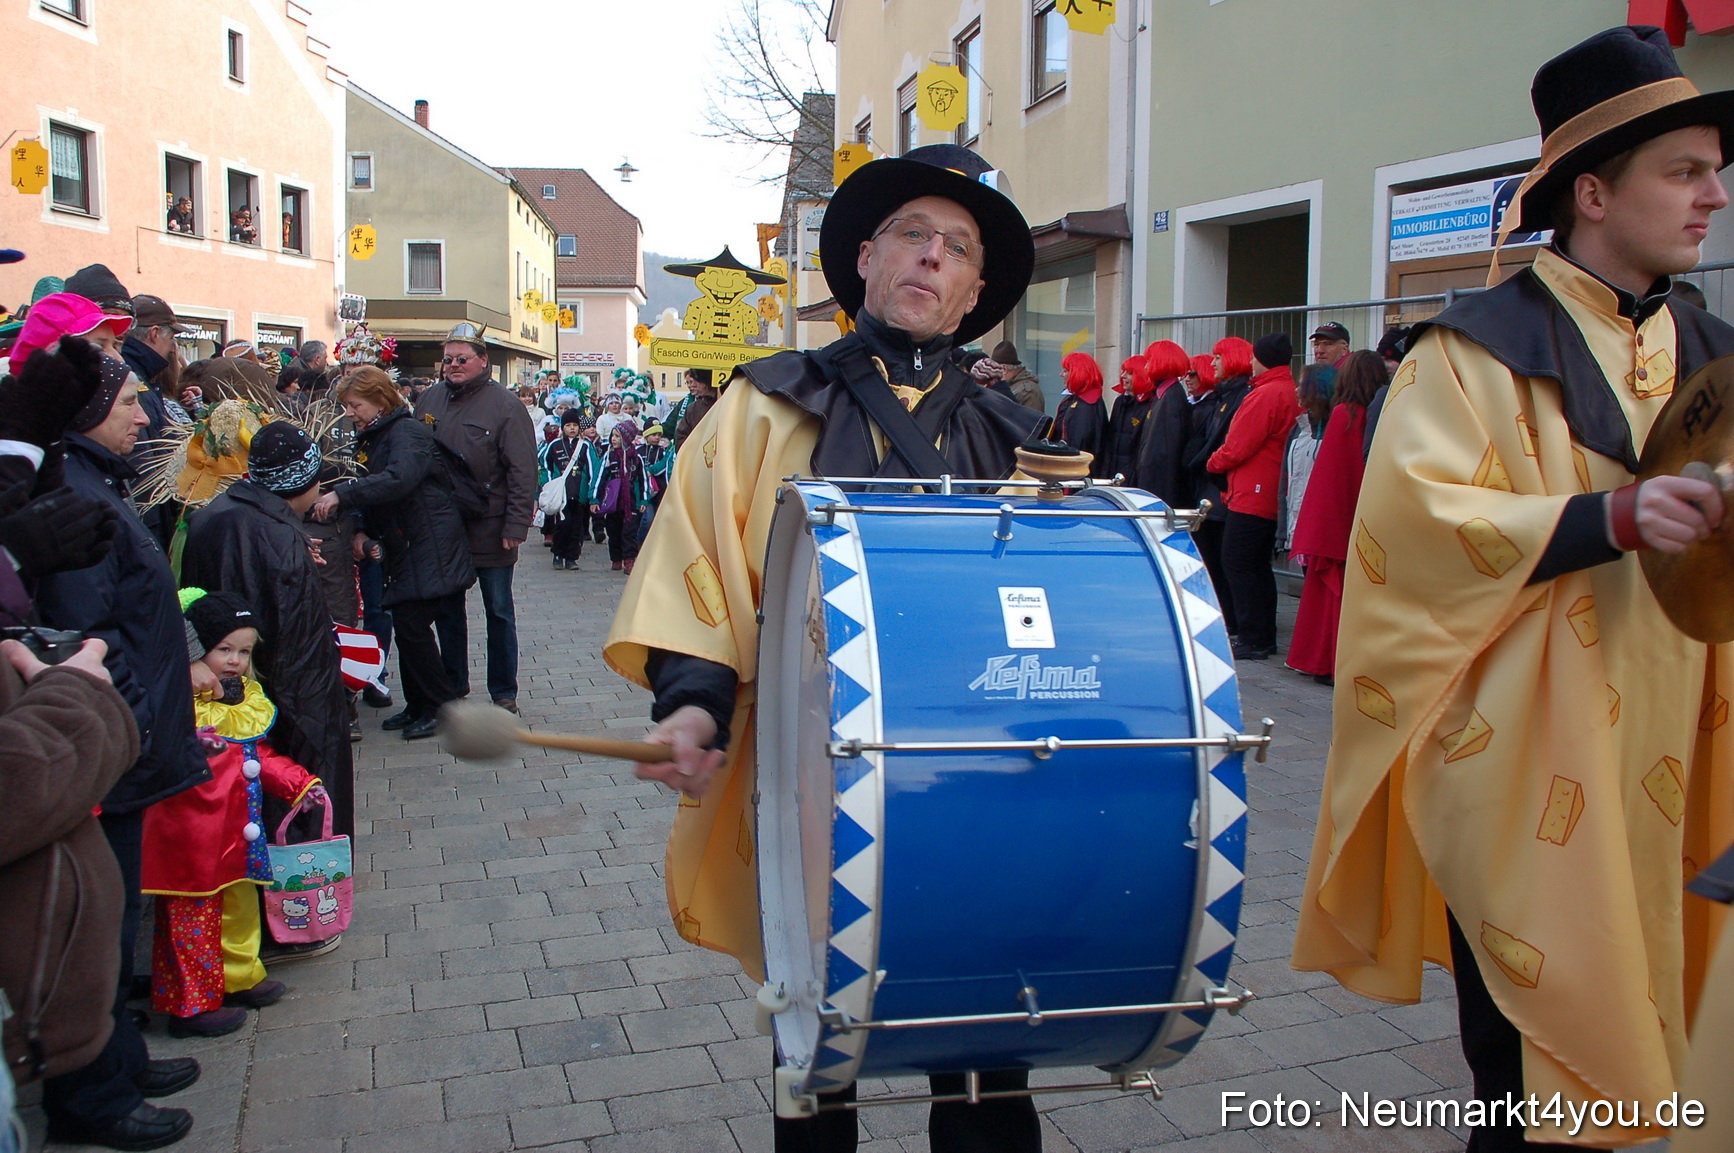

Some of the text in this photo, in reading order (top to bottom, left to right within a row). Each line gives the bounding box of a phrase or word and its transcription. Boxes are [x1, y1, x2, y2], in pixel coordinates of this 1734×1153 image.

[1155, 212, 1166, 223] 42
[1393, 212, 1488, 236] IMMOBILIENBÜRO
[174, 329, 218, 340] ECHANT
[257, 333, 295, 345] DECHANT
[562, 353, 614, 362] ESCHERLE
[657, 347, 689, 358] FaschG
[691, 351, 736, 362] Grün/Weiß
[718, 372, 727, 385] 2
[1029, 691, 1100, 700] PERCUSSION
